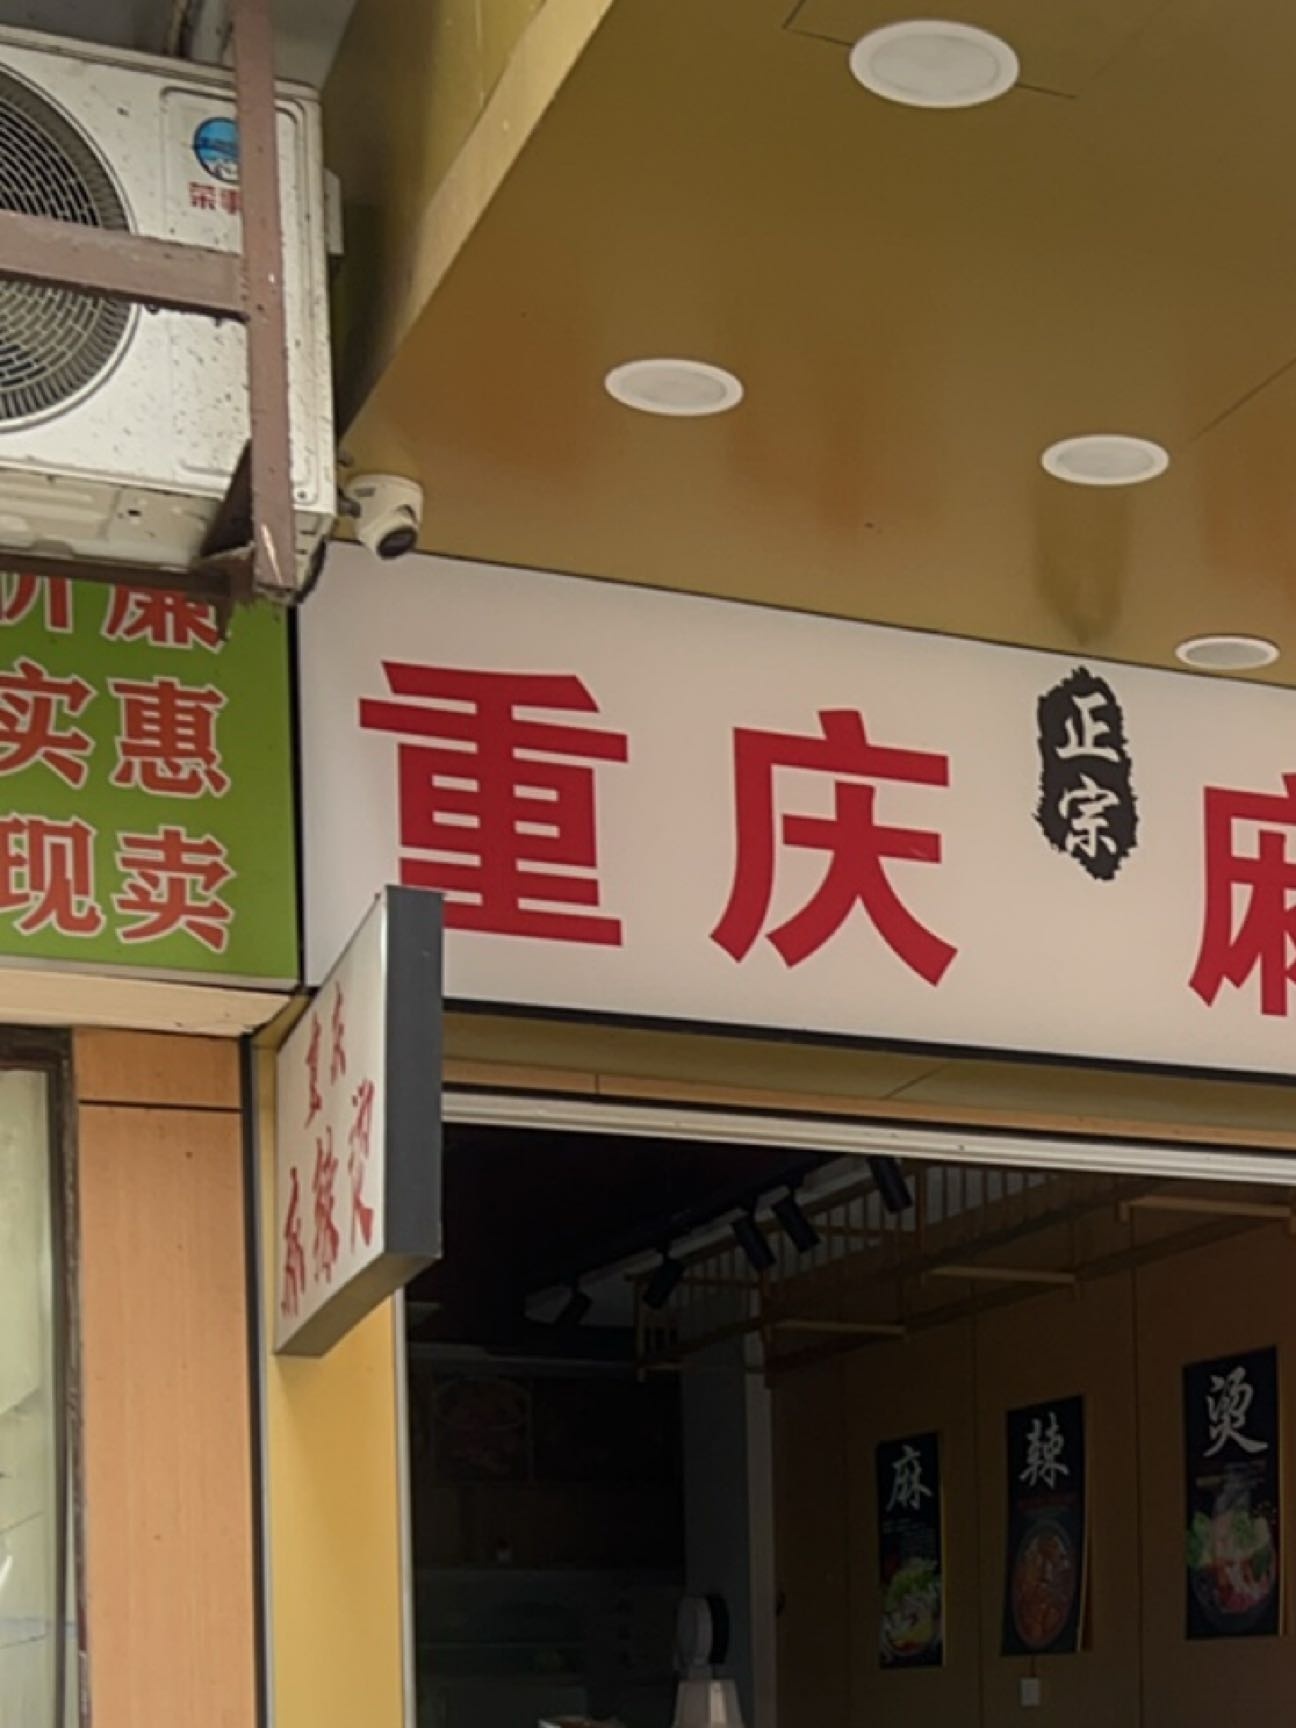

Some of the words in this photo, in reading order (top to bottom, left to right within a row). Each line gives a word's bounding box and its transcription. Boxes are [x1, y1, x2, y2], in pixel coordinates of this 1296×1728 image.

[0, 656, 233, 798] 实惠
[1055, 691, 1121, 859] 正宗
[359, 660, 958, 986] 重庆
[884, 1443, 934, 1513] 麻
